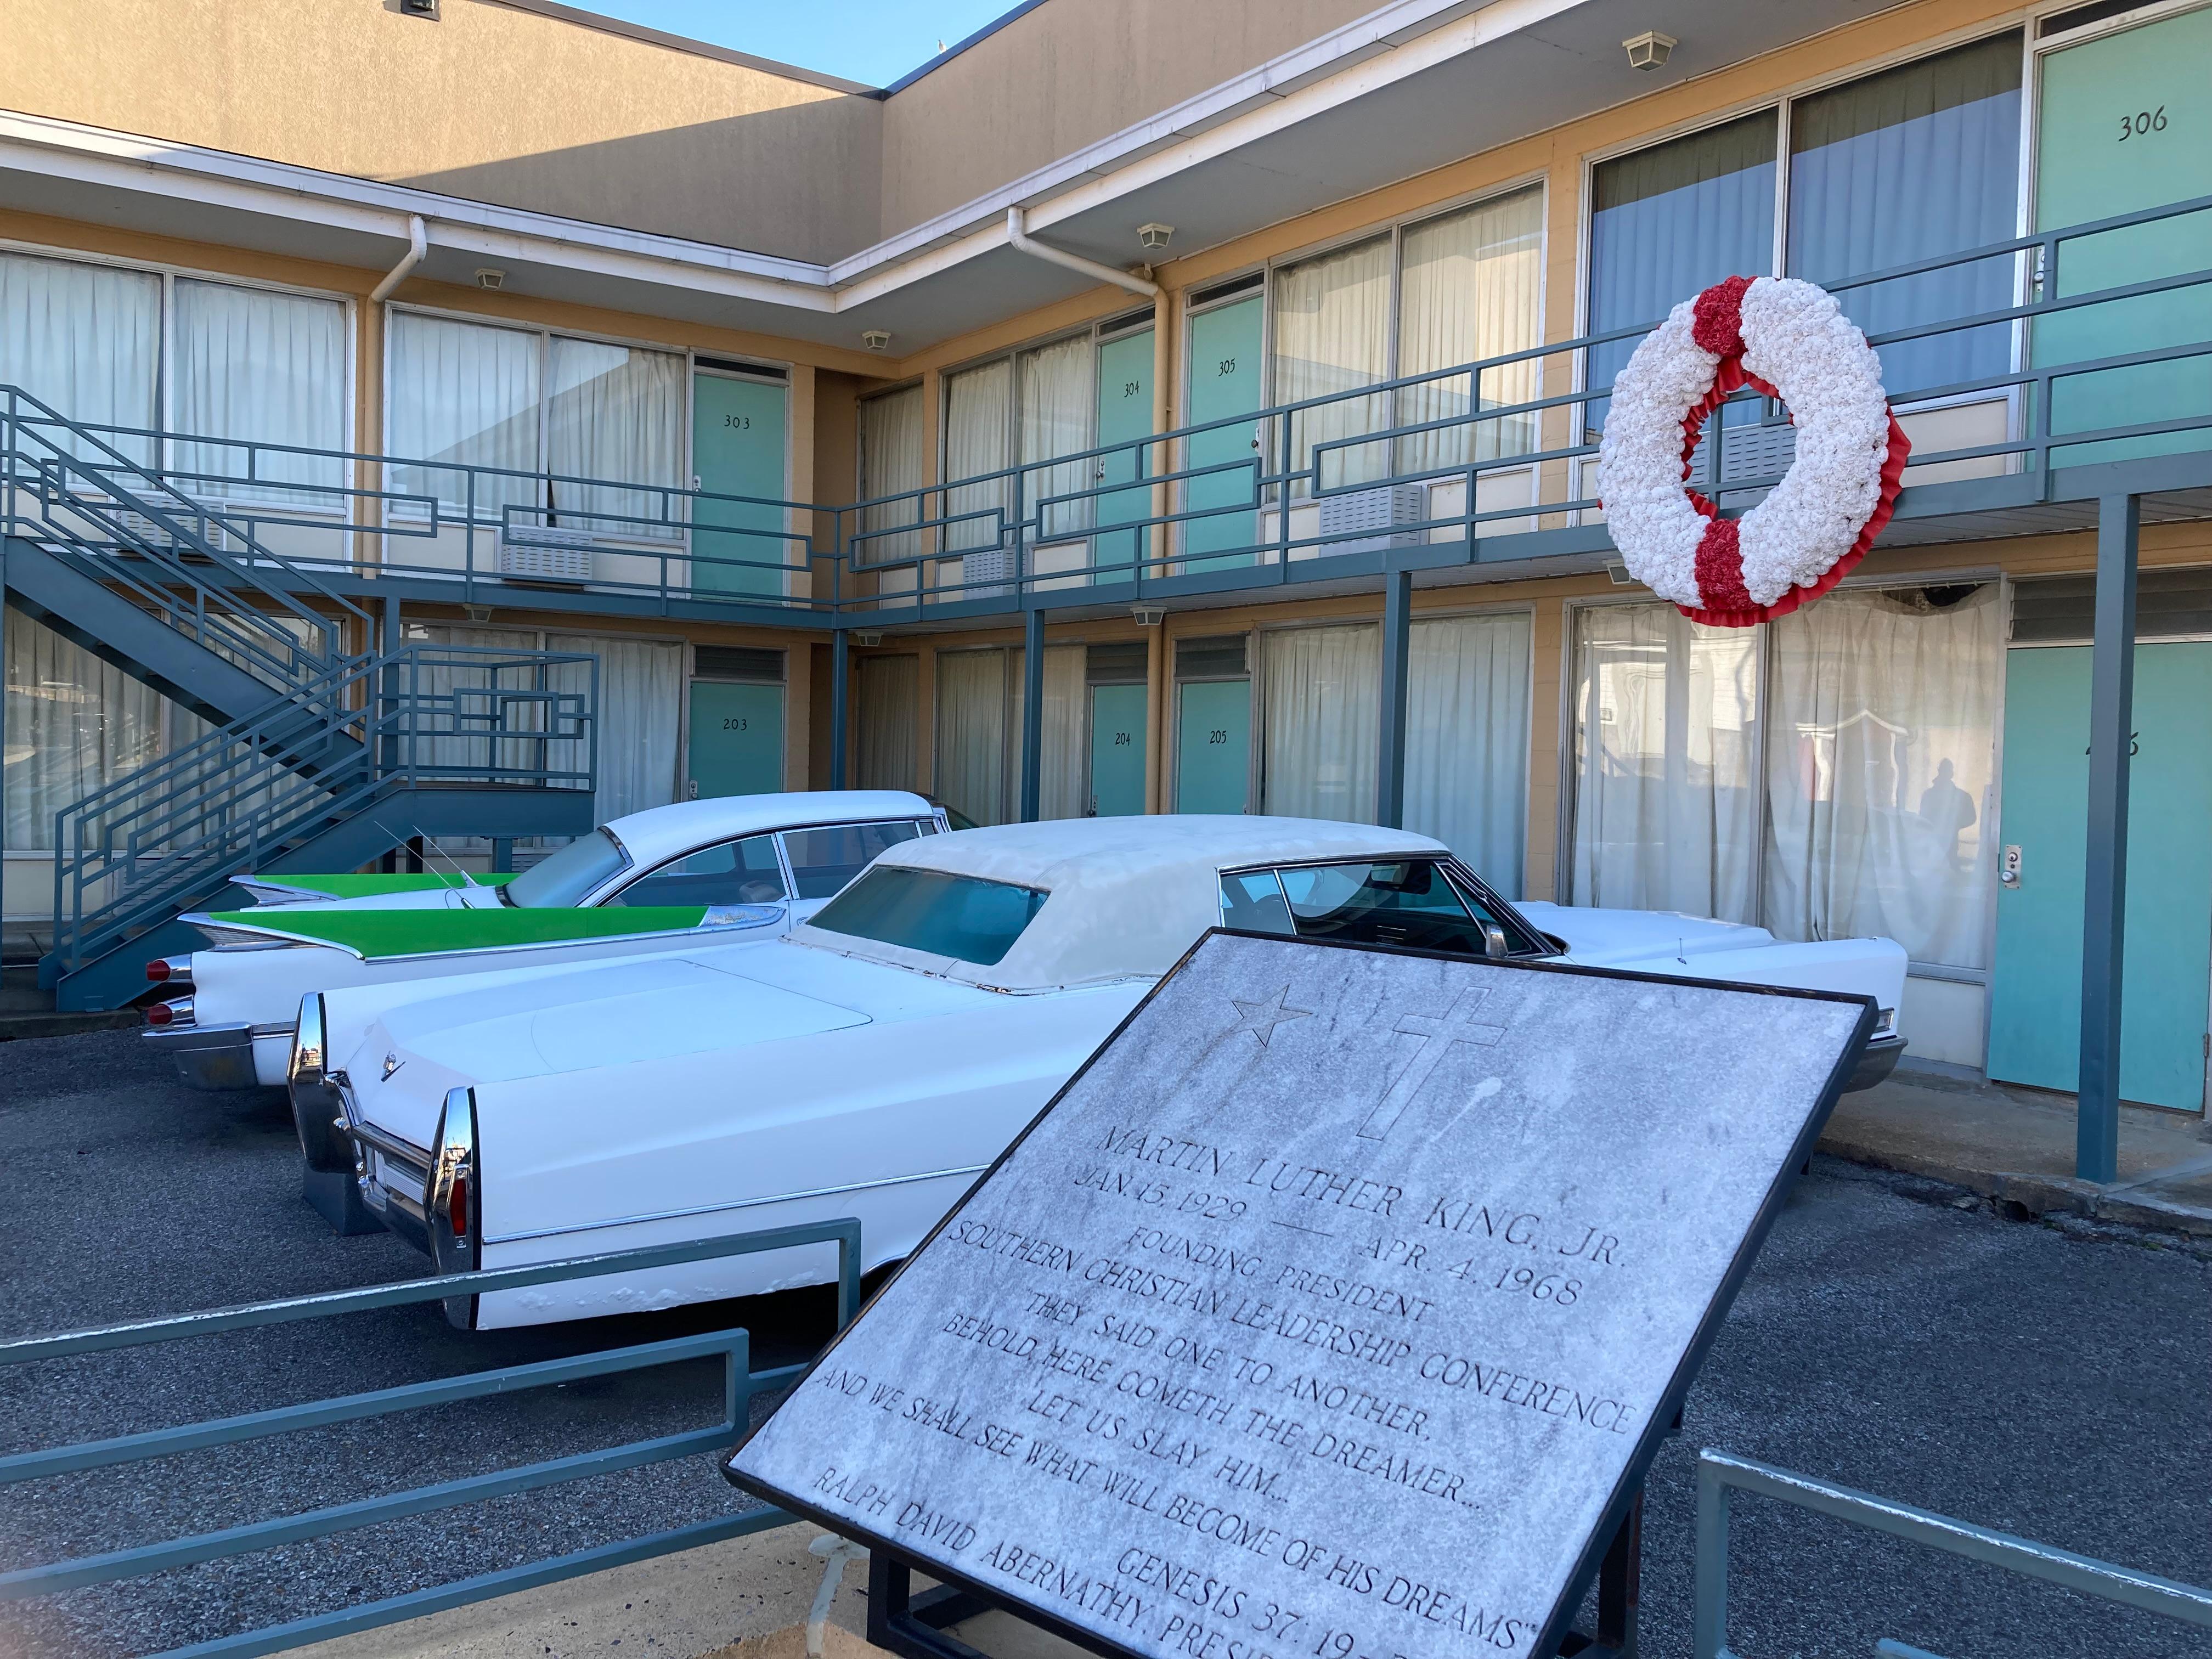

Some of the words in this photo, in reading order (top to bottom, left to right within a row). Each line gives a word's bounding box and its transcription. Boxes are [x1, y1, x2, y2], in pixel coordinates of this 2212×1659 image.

[2118, 105, 2168, 142] 306
[1124, 381, 1139, 398] 304
[1218, 358, 1235, 377] 305
[724, 415, 750, 430] 303
[723, 719, 747, 731] 203
[1115, 732, 1131, 746] 204
[1210, 730, 1227, 744] 205
[1095, 1126, 1235, 1176] MARTIN
[1244, 1158, 1402, 1216] LUTHER
[1558, 1226, 1625, 1267] JR.
[1074, 1167, 1133, 1197] JAN.
[1177, 1190, 1247, 1221] 1929
[1358, 1235, 1431, 1272] APR.
[1494, 1266, 1583, 1305] 1968
[1126, 1226, 1262, 1277] FOUNDING
[1274, 1265, 1435, 1321] PRESIDENT
[948, 1220, 1082, 1273] SOUTHERN
[1084, 1258, 1228, 1315] CHRISTIAN
[1230, 1298, 1410, 1367] LEADERSHIP
[1420, 1352, 1637, 1435] CONFERENCE
[1094, 1314, 1155, 1348] SAID
[1164, 1337, 1224, 1370] ONE
[1234, 1356, 1273, 1385] TO
[1028, 1390, 1081, 1423] LET
[1086, 1409, 1127, 1440] US
[1133, 1427, 1210, 1469] SLAY
[1042, 1345, 1111, 1383] HERE
[1117, 1371, 1235, 1424] COMETH
[1243, 1409, 1303, 1447] THE
[812, 1467, 896, 1516] RALPH
[896, 1500, 976, 1551] DAVID
[816, 1368, 867, 1397] AND
[870, 1383, 905, 1411] WE
[903, 1397, 973, 1440] SHALL
[974, 1424, 1023, 1457] SEE
[1025, 1440, 1098, 1484] WHAT
[1103, 1470, 1158, 1511] WILL
[1164, 1494, 1280, 1556] BECOME
[1283, 1539, 1327, 1572] OF
[1325, 1555, 1380, 1594] HIS
[1118, 1548, 1248, 1619] GENESIS
